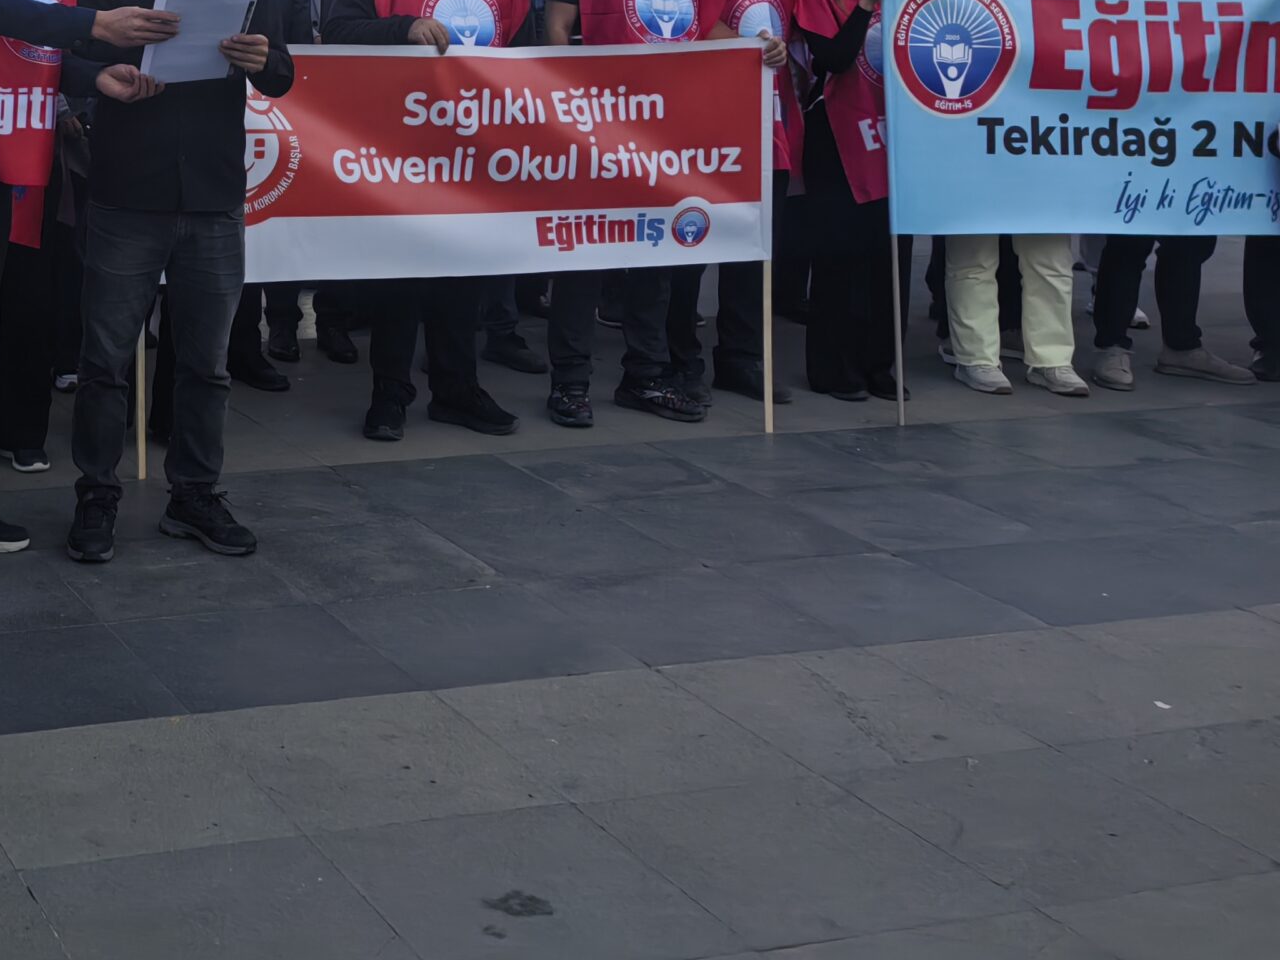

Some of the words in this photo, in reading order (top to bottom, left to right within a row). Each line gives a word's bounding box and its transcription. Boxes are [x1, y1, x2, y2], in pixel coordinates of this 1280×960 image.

[907, 0, 918, 14] VE
[403, 87, 546, 136] Sağlıklı
[557, 86, 664, 129] Eğitim
[333, 147, 475, 185] Güvenli
[488, 145, 577, 183] Okul
[590, 137, 742, 186] İstiyoruz
[978, 114, 1177, 167] Tekirdağ
[1191, 120, 1218, 157] 2
[253, 171, 295, 211] KORUMAKLA
[288, 135, 303, 170] BAŞLAR
[1114, 171, 1148, 224] İyi
[1156, 178, 1176, 210] ki
[535, 213, 666, 252] Eğitimiş
